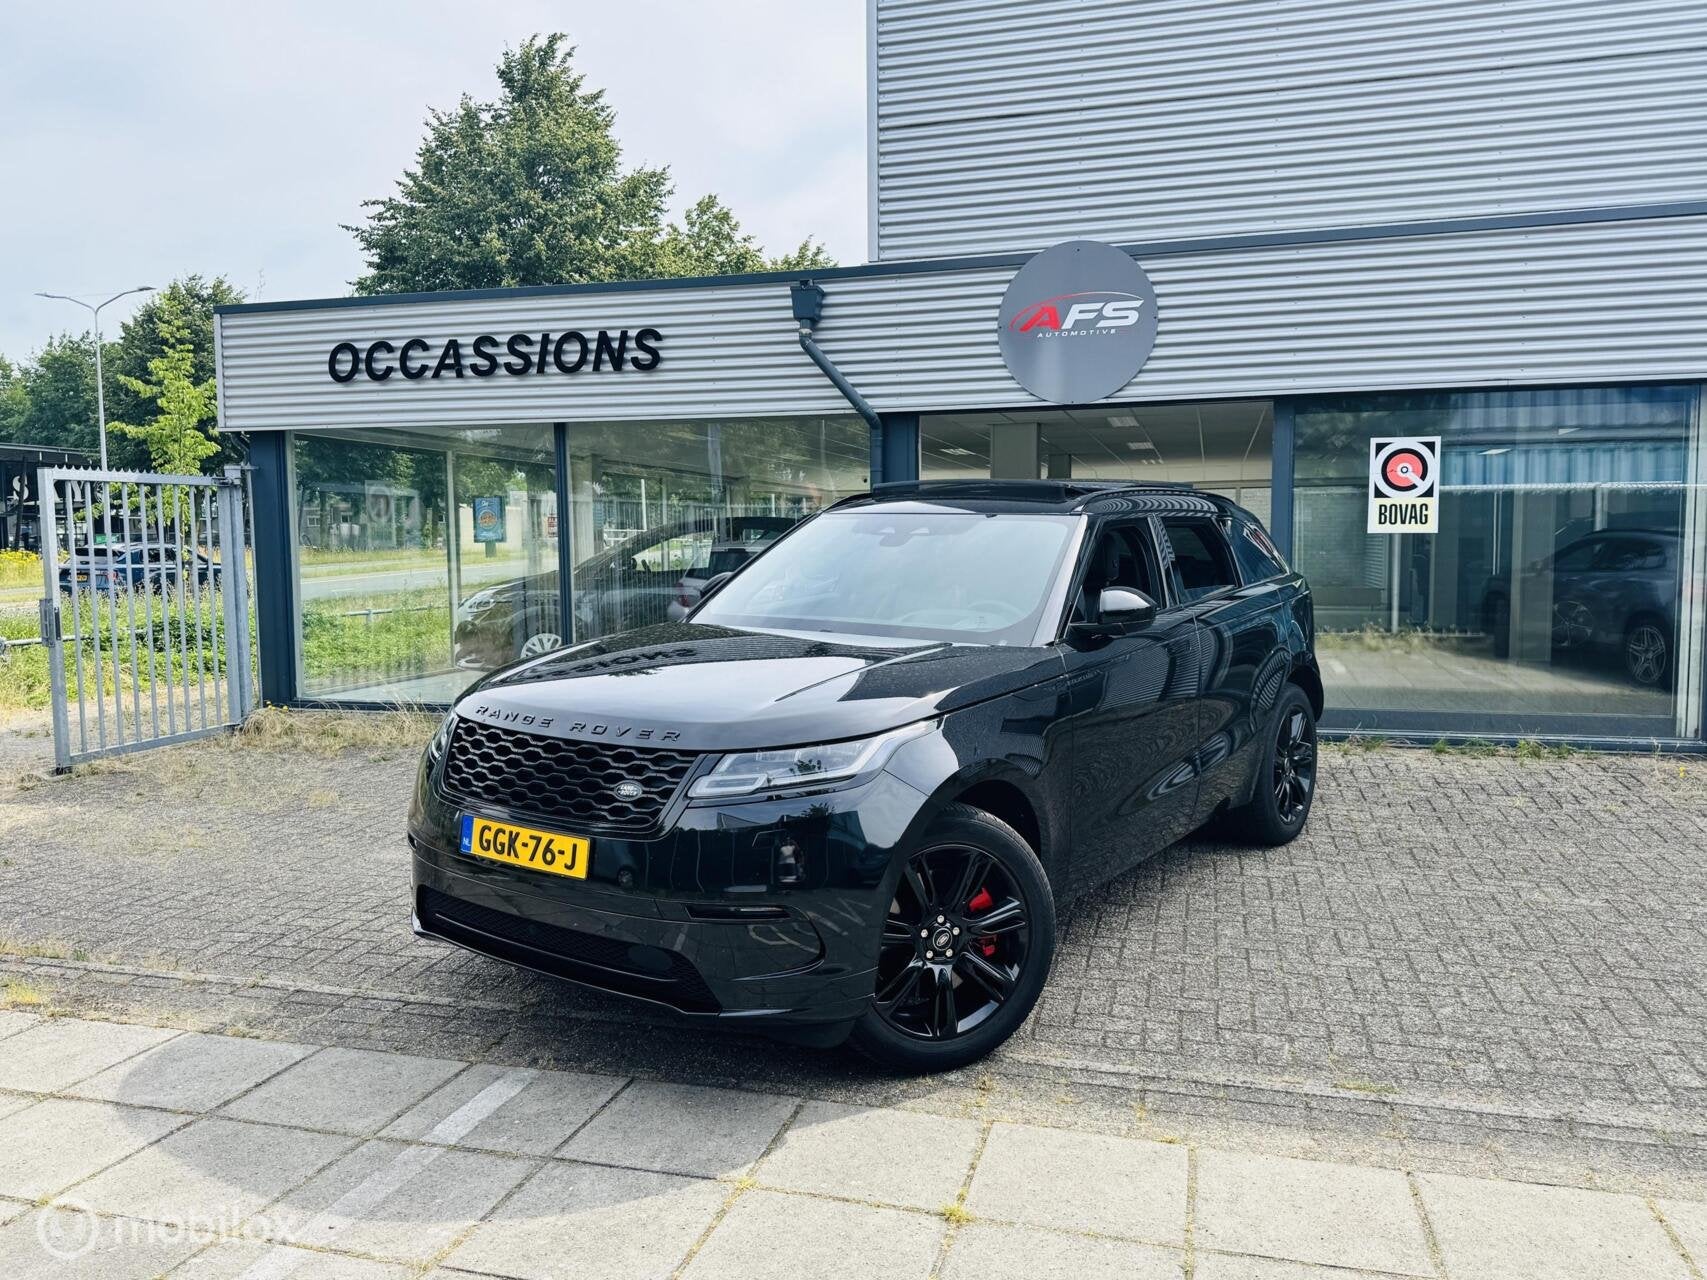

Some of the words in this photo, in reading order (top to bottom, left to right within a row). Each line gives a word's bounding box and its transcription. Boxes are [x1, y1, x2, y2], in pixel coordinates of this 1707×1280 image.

[1019, 299, 1144, 332] AFS
[1037, 328, 1118, 338] AUTOMOTIVE
[328, 328, 663, 383] OCCASSIONS
[1378, 503, 1429, 525] BOVAG
[476, 705, 554, 729] RANGE
[569, 720, 681, 742] ROVER
[479, 824, 578, 871] GGK-76-J
